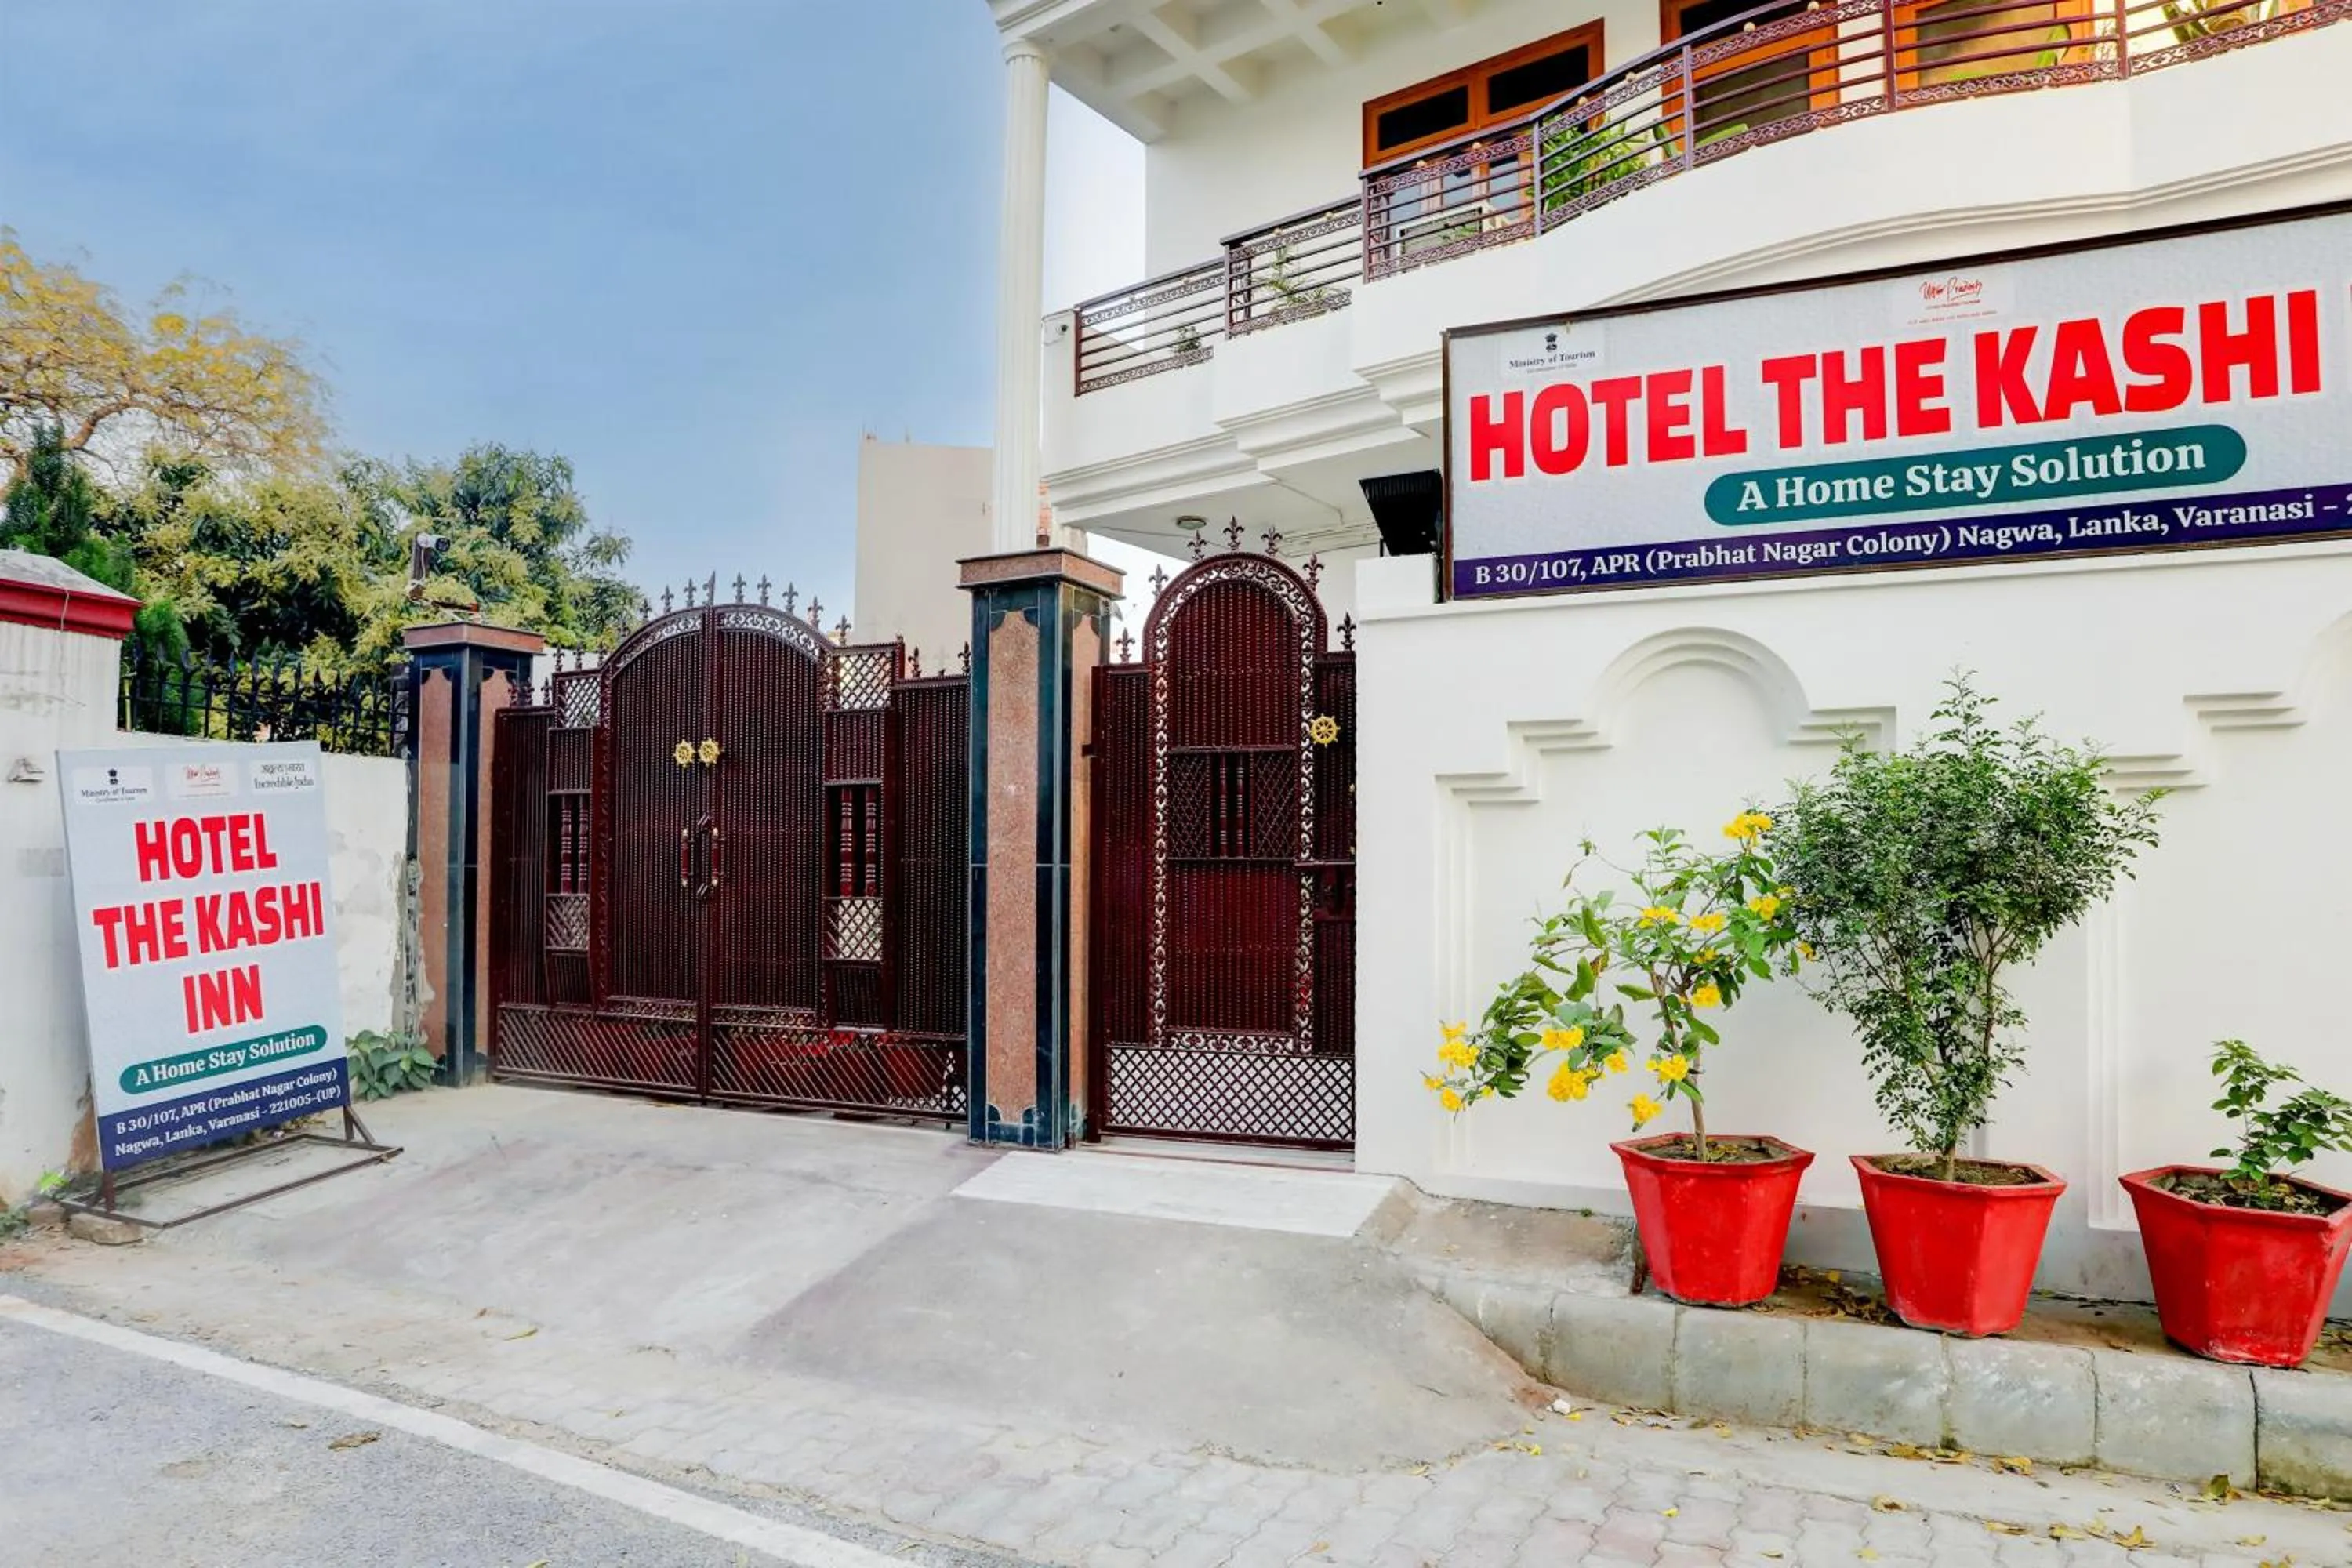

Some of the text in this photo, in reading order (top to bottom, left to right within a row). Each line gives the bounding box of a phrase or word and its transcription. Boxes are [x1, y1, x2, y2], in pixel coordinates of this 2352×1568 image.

[1470, 289, 2321, 481] HOTEL THE KASHI
[1737, 438, 2207, 512] A Home Stay Solution
[1475, 566, 1490, 584] B
[1496, 559, 1586, 586] 30/107,
[1592, 554, 1641, 575] APR
[1646, 541, 1757, 574] (Prabhat
[1762, 539, 1842, 564] Nagar
[1846, 526, 1951, 557] Colony)
[1958, 521, 2063, 549] Nagwa,
[2068, 510, 2169, 539] Lanka,
[2172, 493, 2315, 528] Varanasi
[135, 813, 278, 883] HOTEL
[93, 882, 325, 969] THE KASHI
[183, 964, 263, 1034] INN
[136, 1033, 316, 1087] A Home Stay Solution
[115, 1137, 164, 1156] Nagwa,
[165, 1123, 208, 1143] Lanka,
[208, 1106, 260, 1131] Varanasi
[117, 1067, 338, 1134] B 30/107, APR (Prabhat Nagar Colony)
